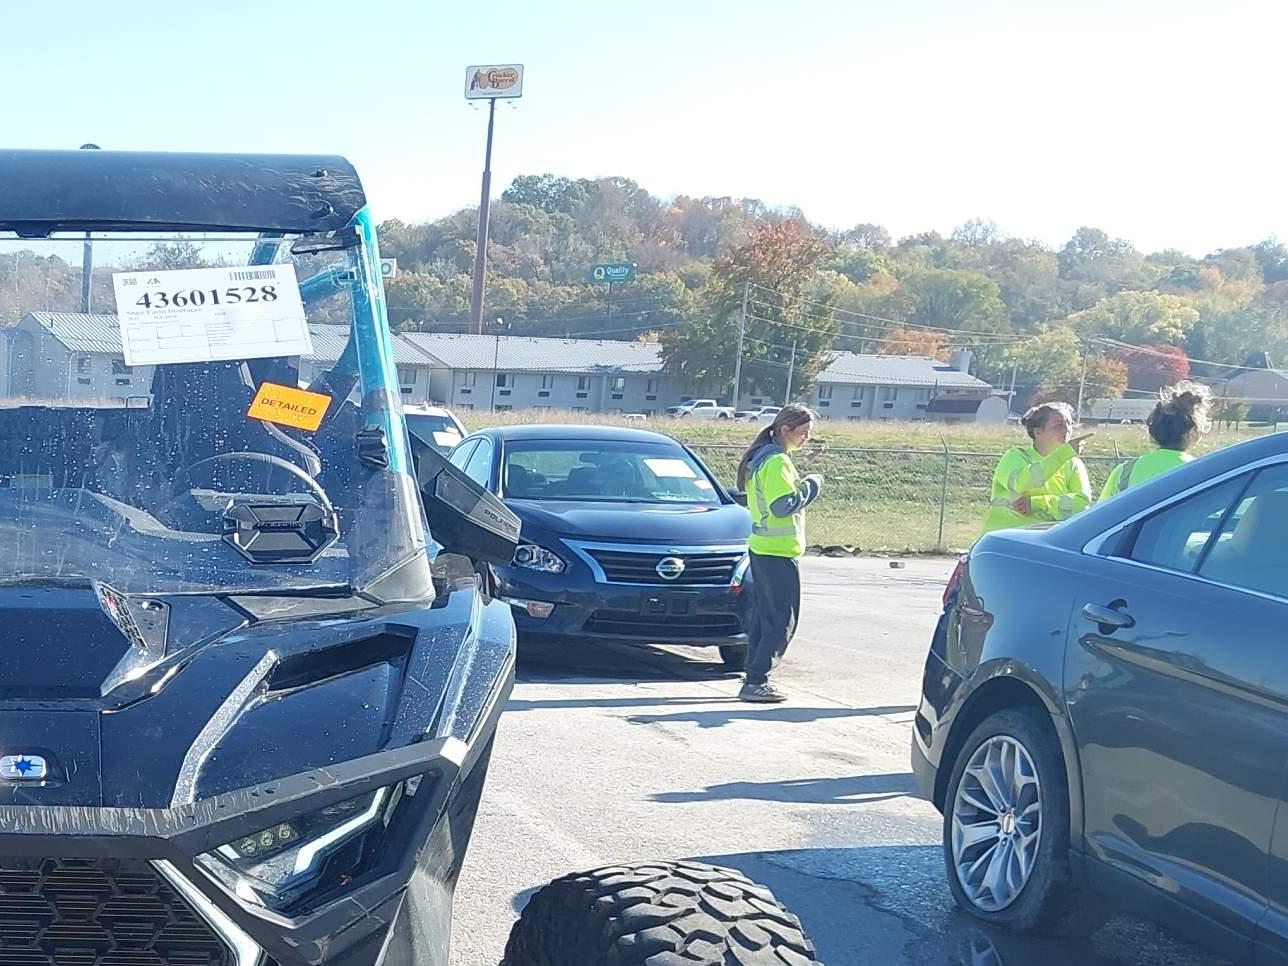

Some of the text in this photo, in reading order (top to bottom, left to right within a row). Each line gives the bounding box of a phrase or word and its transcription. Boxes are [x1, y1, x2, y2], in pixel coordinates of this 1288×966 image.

[606, 266, 629, 275] Quality
[136, 285, 279, 309] 43601528
[261, 397, 317, 416] DETAILED
